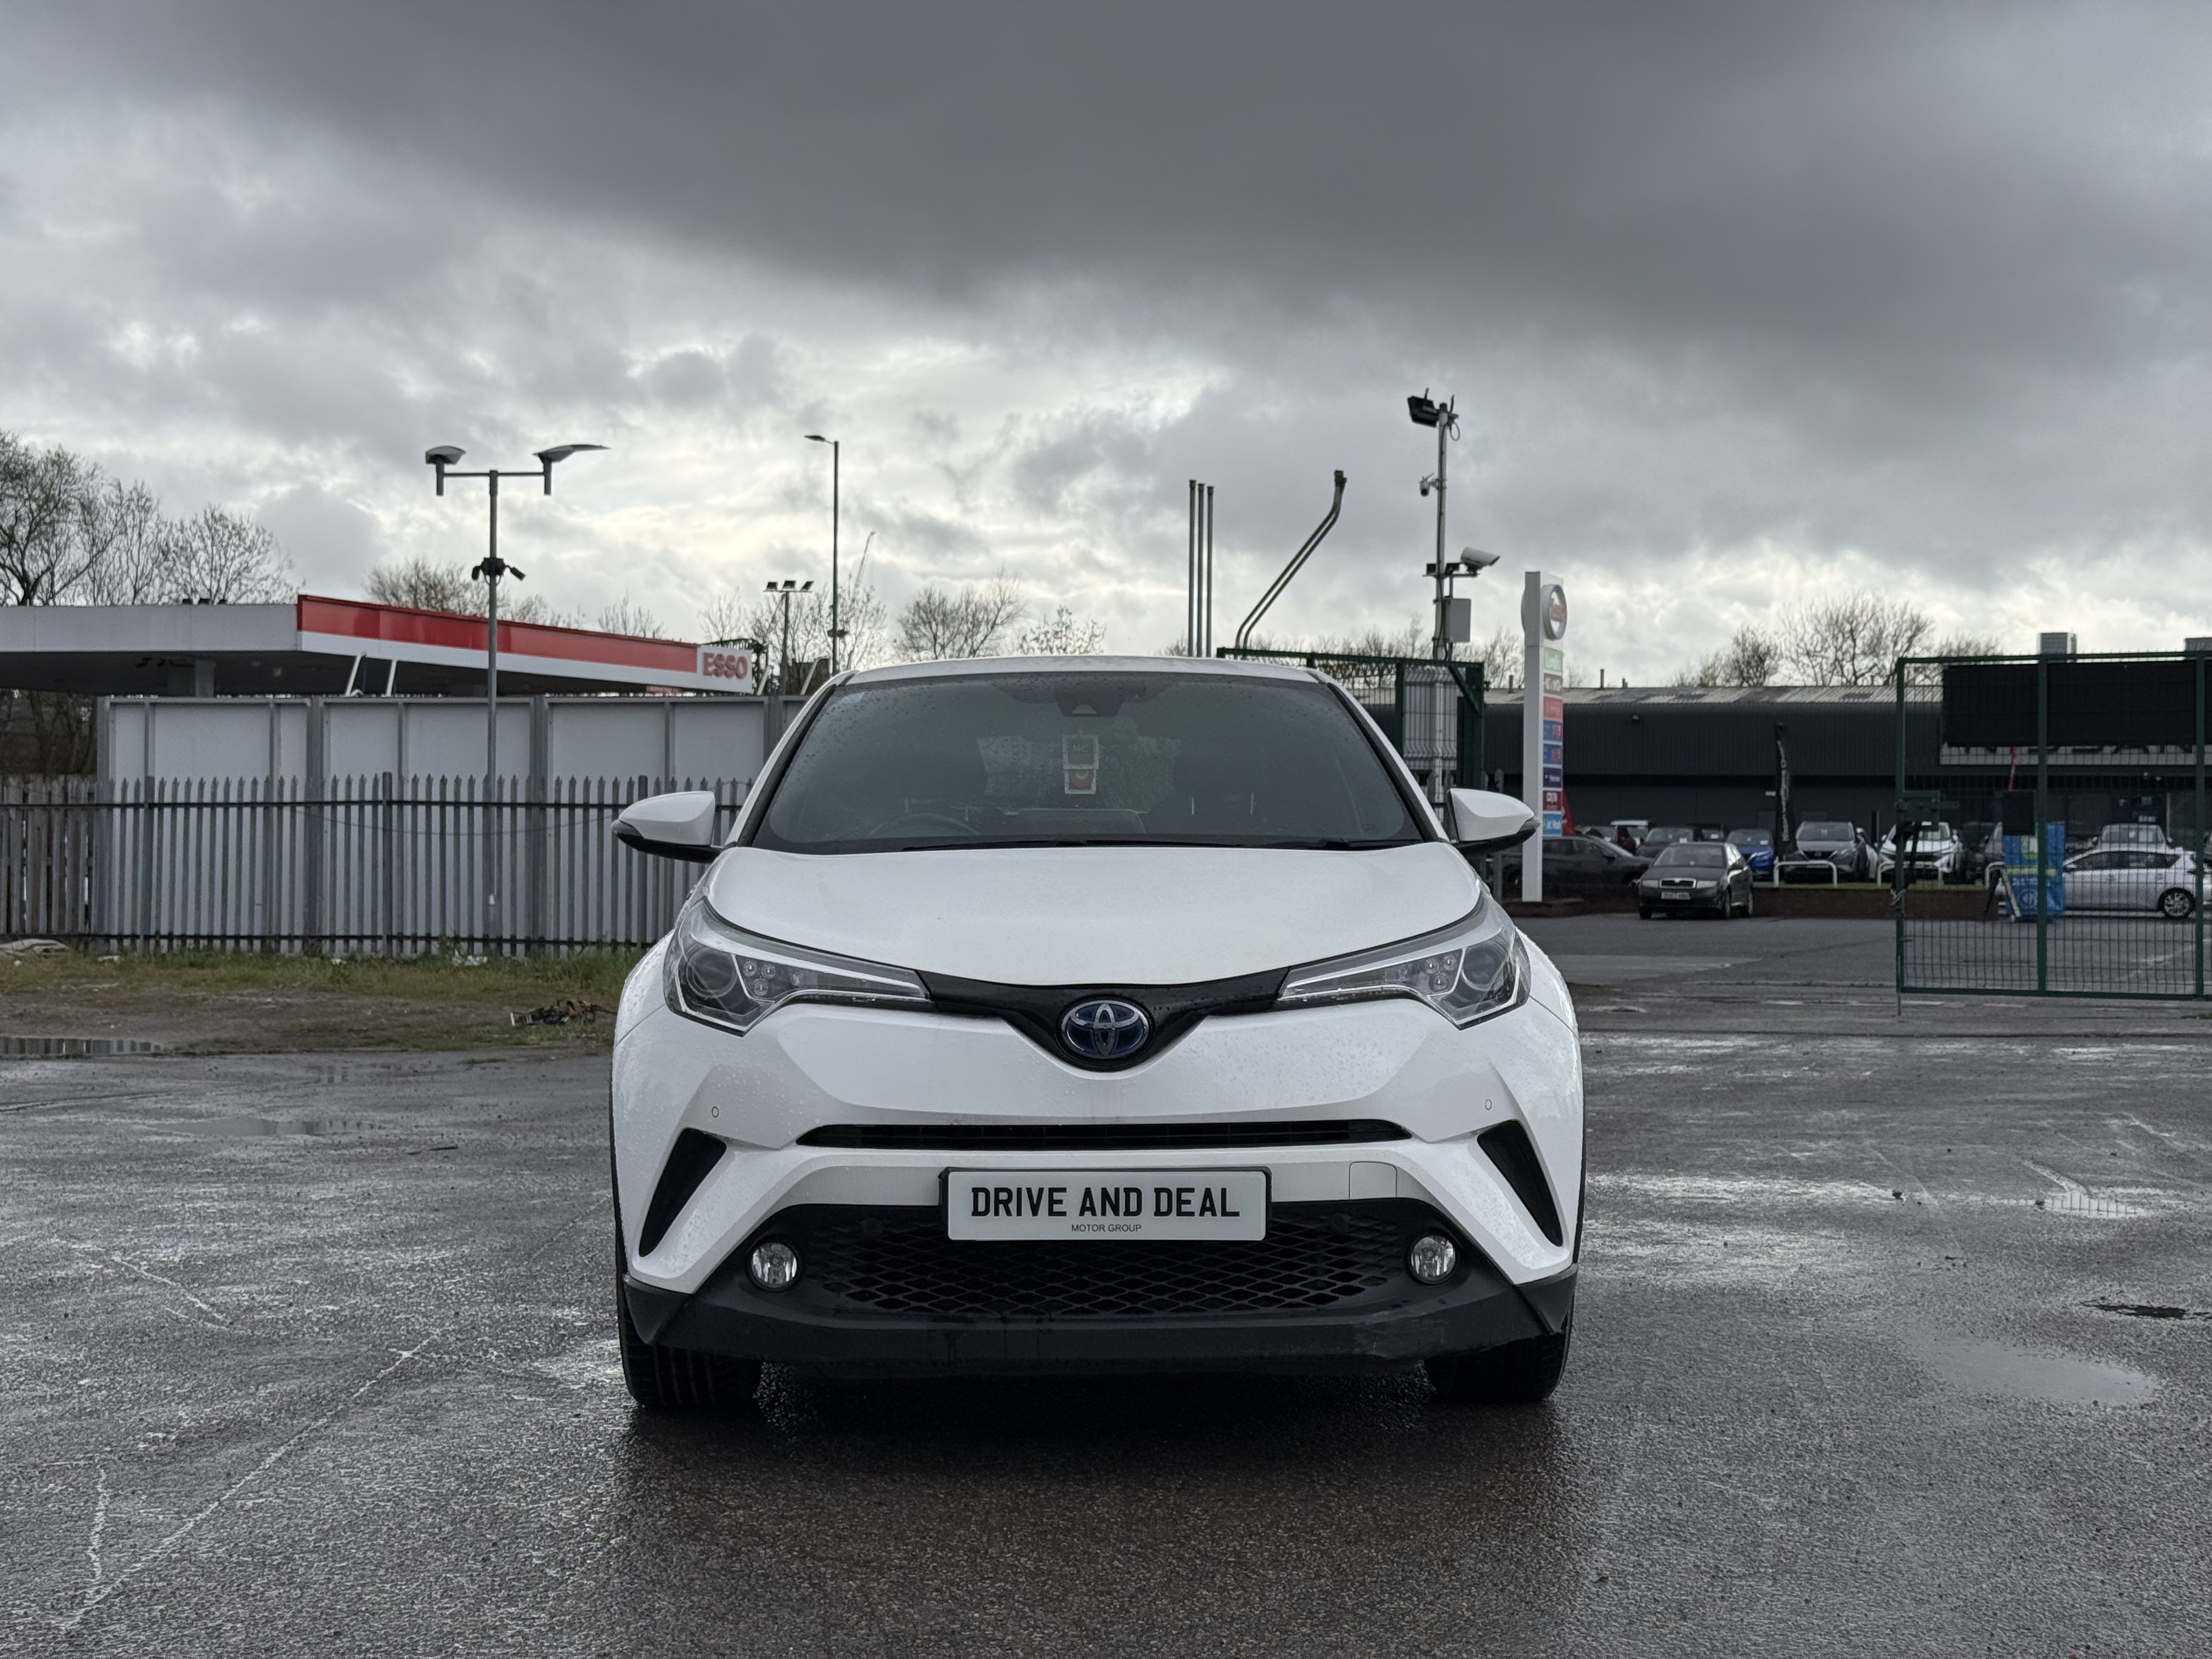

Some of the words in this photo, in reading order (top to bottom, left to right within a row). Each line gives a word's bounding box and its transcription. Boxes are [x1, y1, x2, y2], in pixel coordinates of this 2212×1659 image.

[971, 1187, 1068, 1217] DRIVE
[1079, 1187, 1143, 1217] AND
[1154, 1187, 1240, 1217] DEAL
[1071, 1223, 1106, 1233] MOTOR
[1108, 1223, 1142, 1233] GROUP
